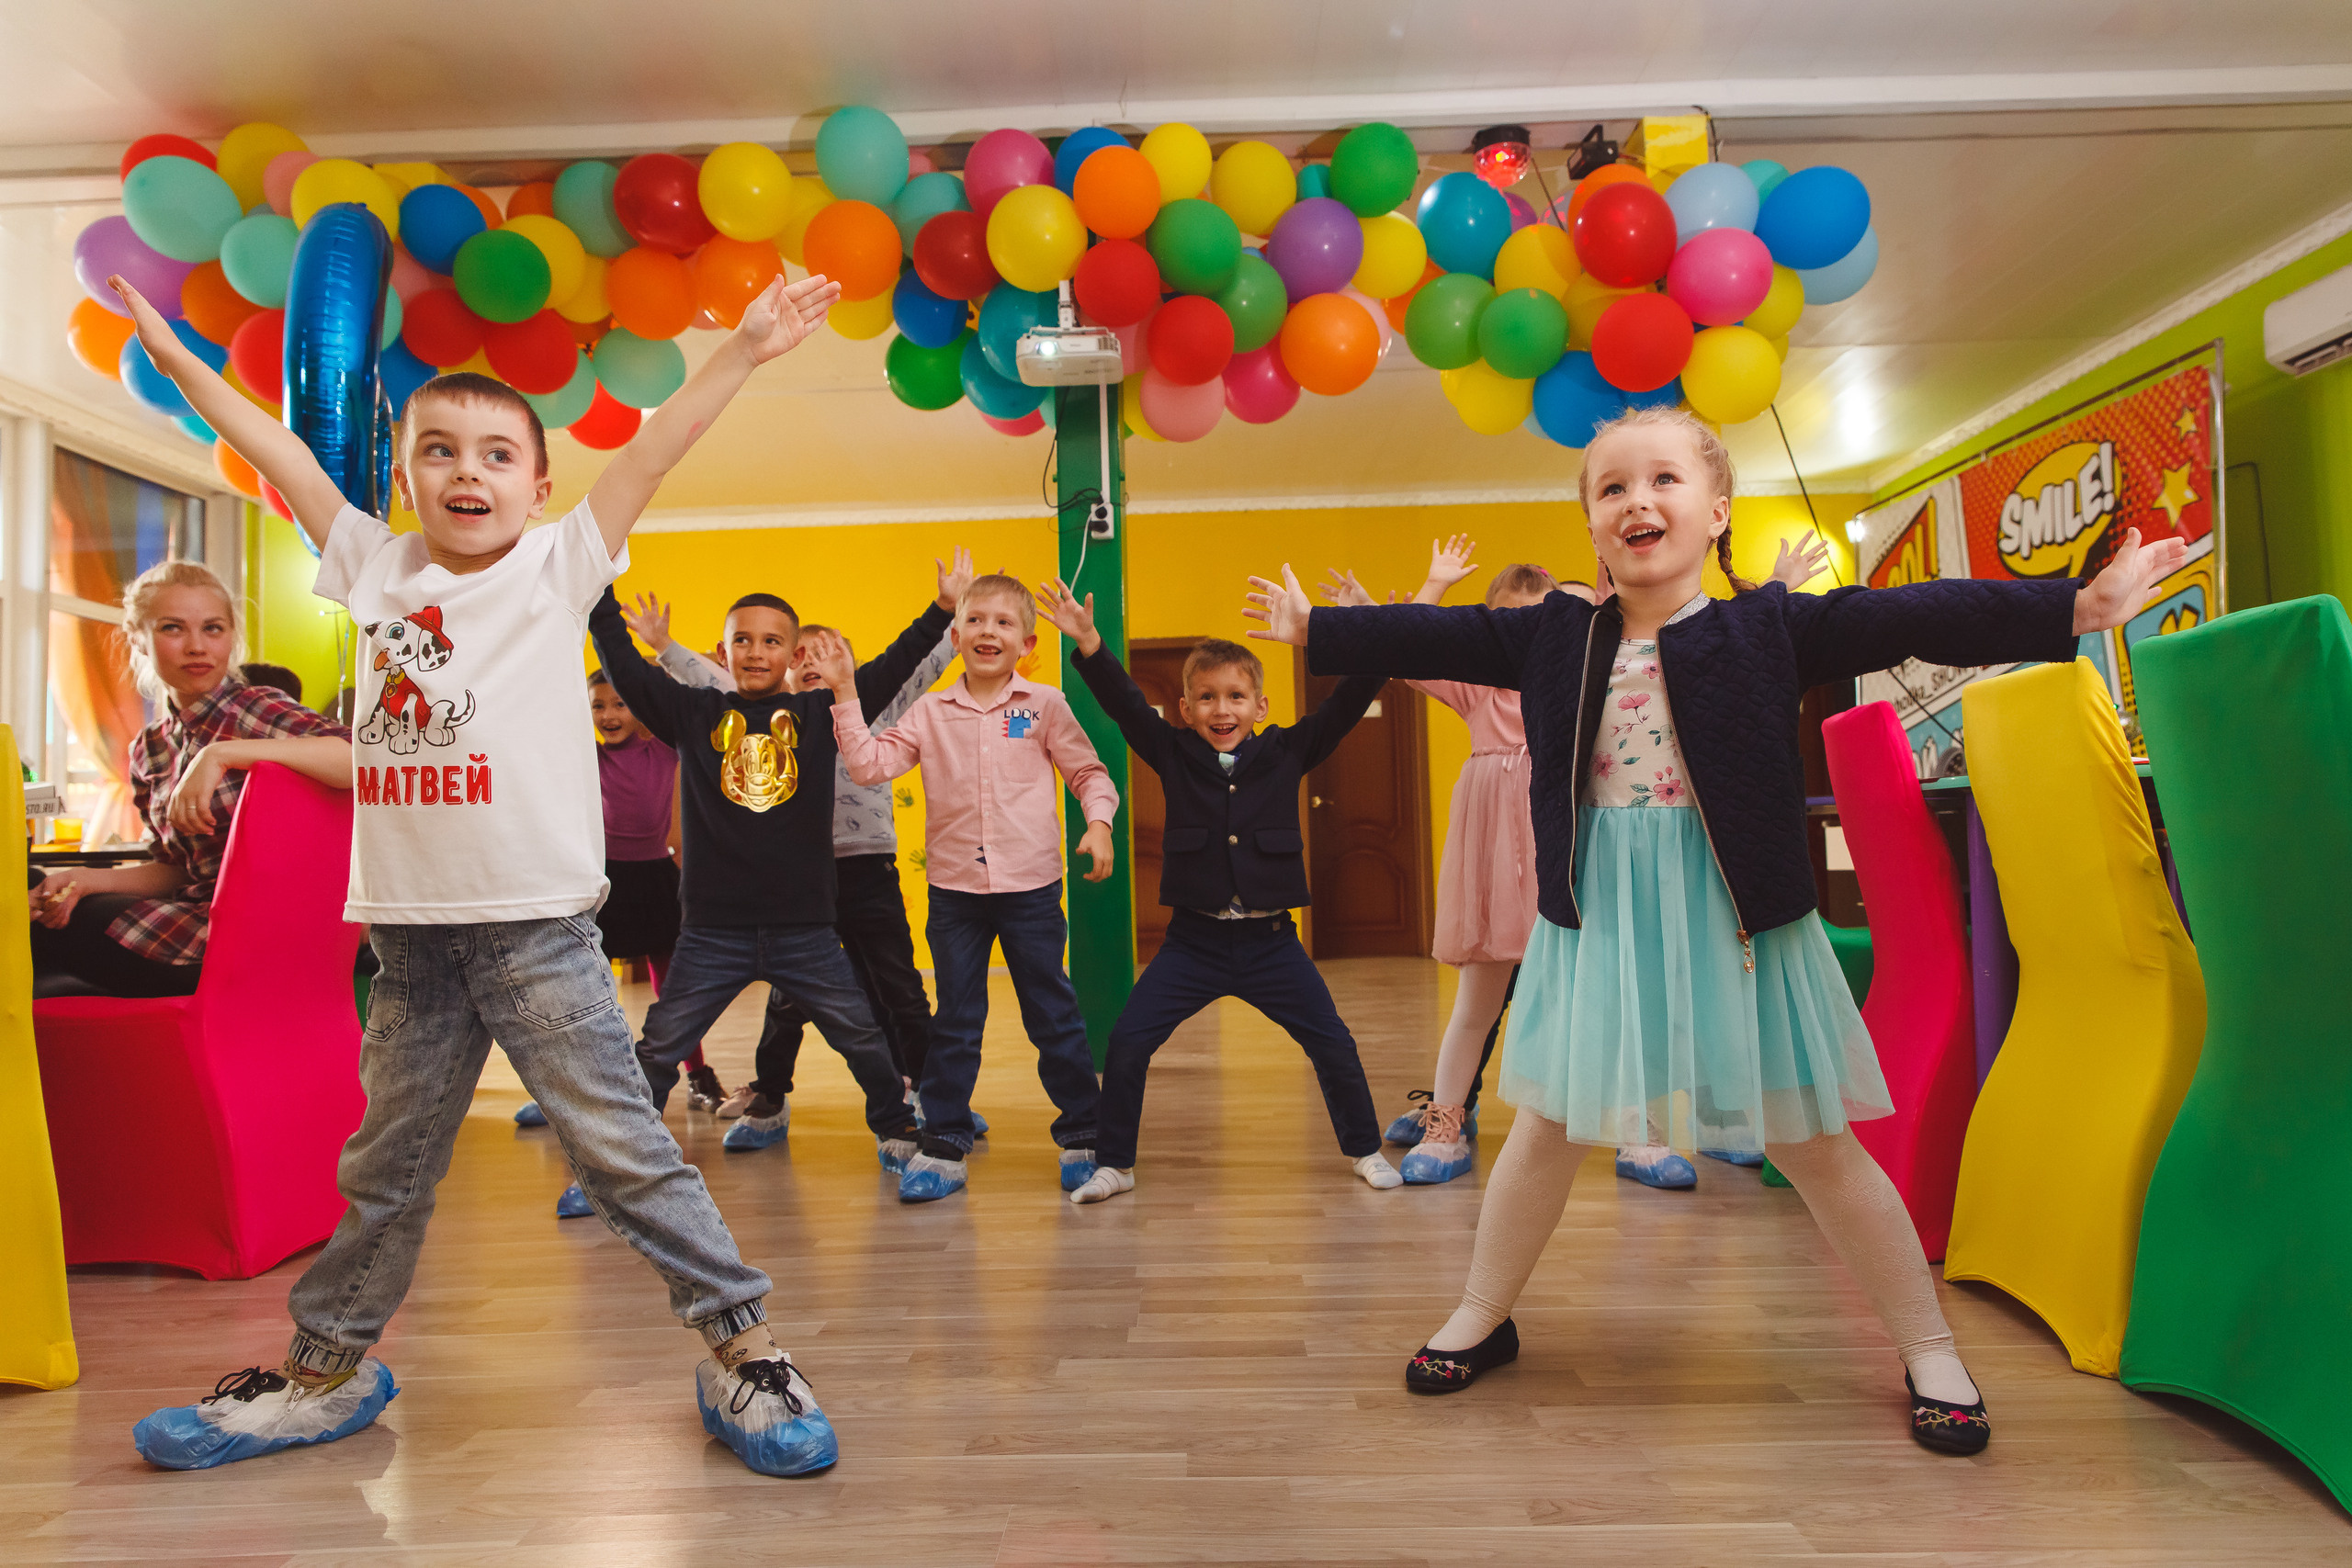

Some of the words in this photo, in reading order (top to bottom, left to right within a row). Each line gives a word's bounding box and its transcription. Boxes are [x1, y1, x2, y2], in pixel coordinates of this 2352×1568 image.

[1997, 441, 2116, 558] SMILE!
[1003, 707, 1040, 721] LOOK
[356, 753, 492, 806] МАТВЕЙ
